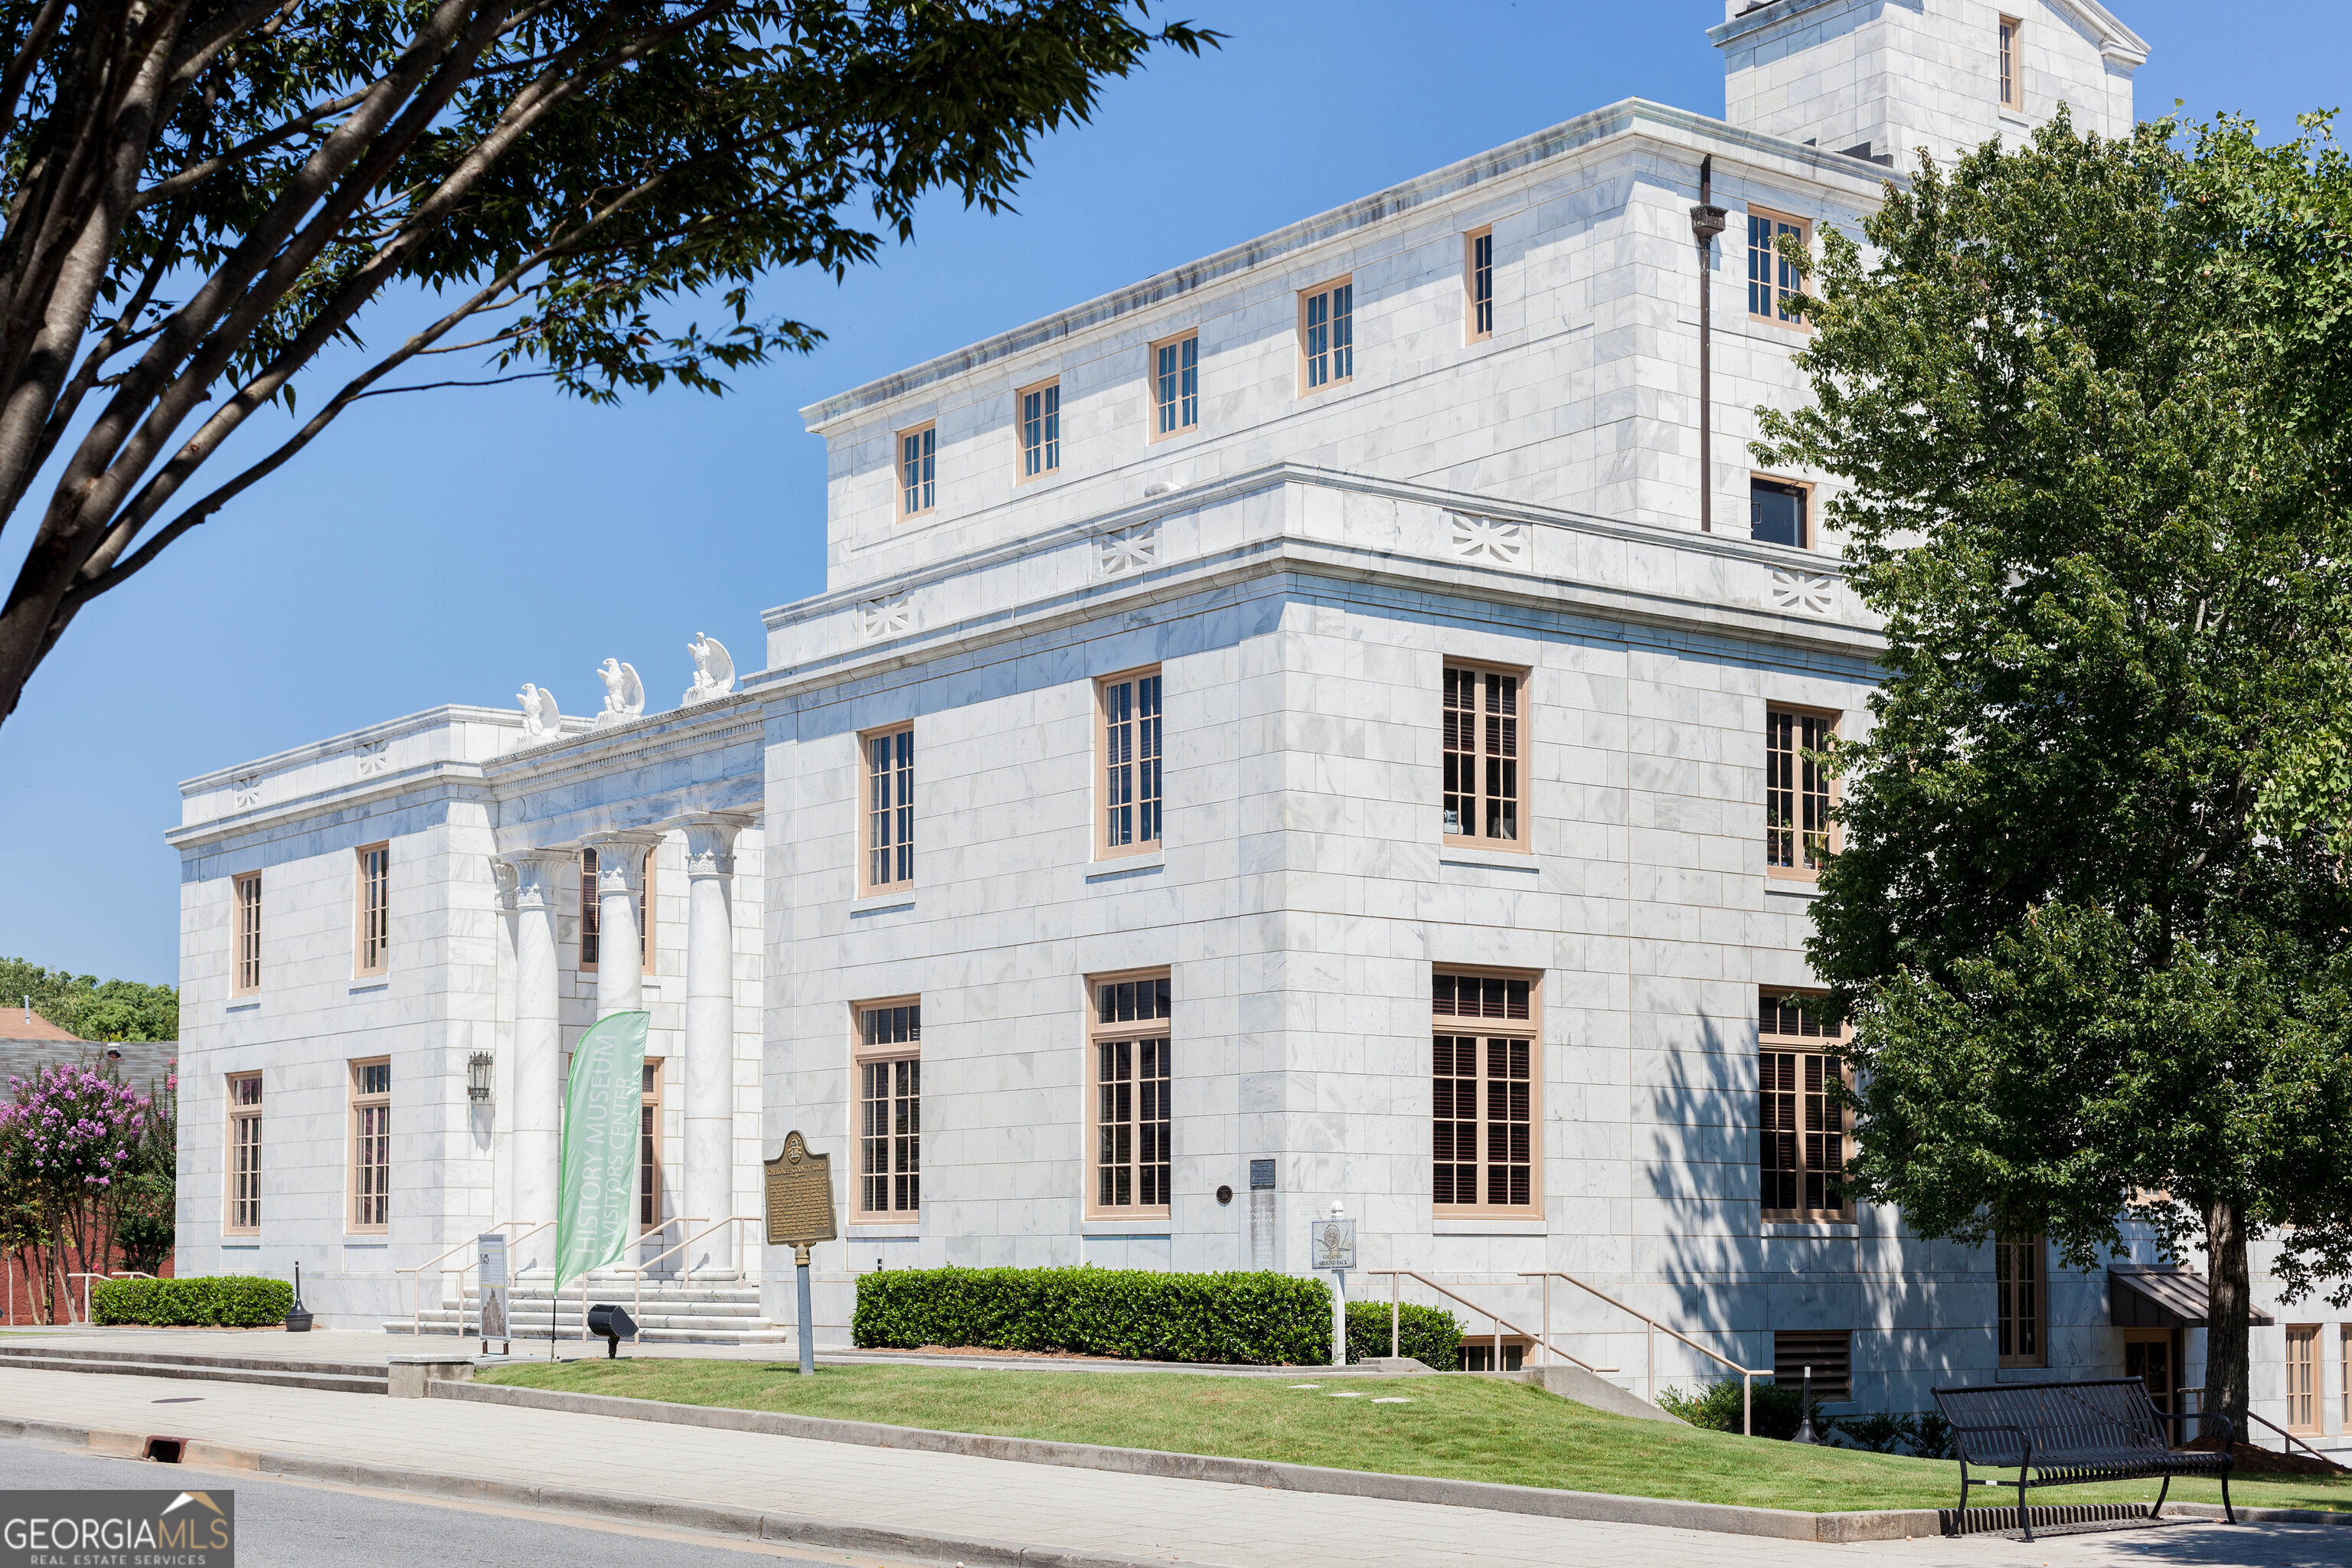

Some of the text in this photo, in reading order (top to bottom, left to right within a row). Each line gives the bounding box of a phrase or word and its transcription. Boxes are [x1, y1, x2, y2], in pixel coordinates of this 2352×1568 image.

[575, 1034, 616, 1253] HISTORY MUSEUM
[609, 1077, 632, 1150] CENTER
[602, 1155, 624, 1238] VISITORS
[792, 1164, 812, 1174] COUNTY
[813, 1162, 827, 1172] GOLD
